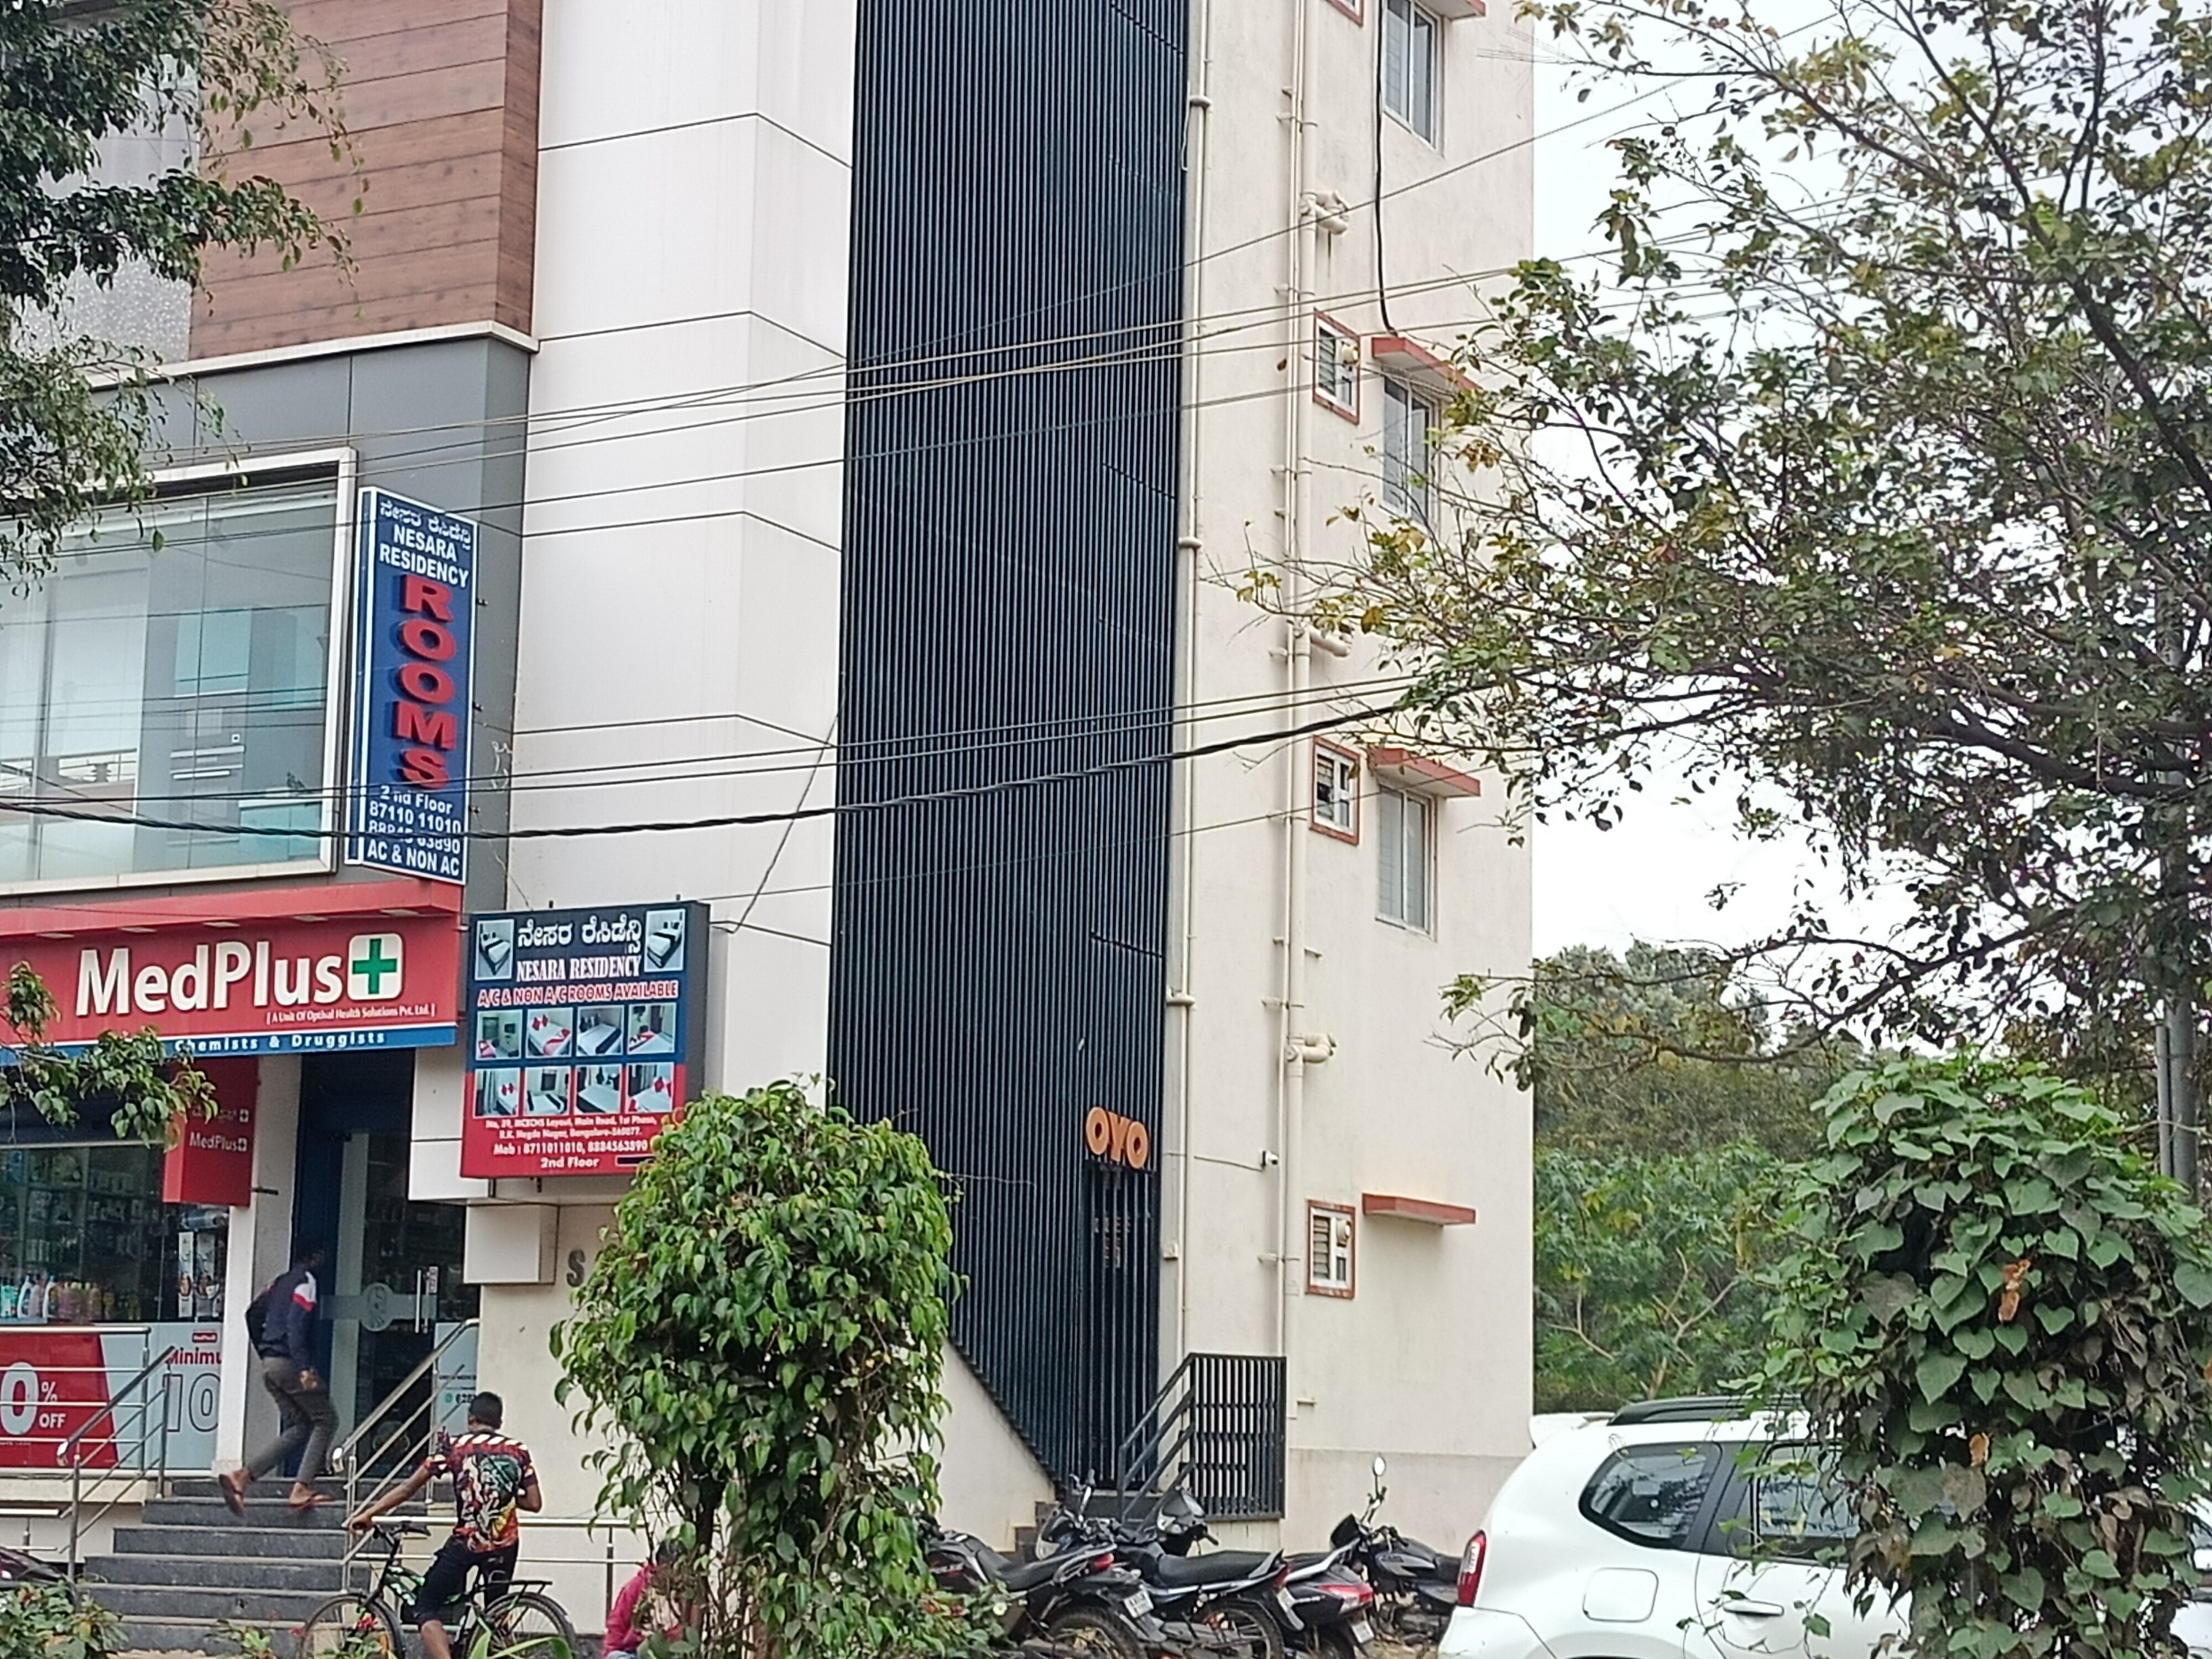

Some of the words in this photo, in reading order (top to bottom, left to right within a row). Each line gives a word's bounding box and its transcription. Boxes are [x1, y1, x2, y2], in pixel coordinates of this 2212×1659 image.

[393, 524, 457, 562] NESARA
[379, 543, 469, 588] RESIDENCY
[394, 573, 457, 789] ROOMS
[369, 801, 414, 825] 87110
[419, 812, 462, 834] 11010
[415, 794, 453, 815] Floor
[367, 839, 388, 860] AC
[392, 844, 402, 864] &
[406, 847, 437, 872] NON
[441, 855, 460, 876] AC
[518, 919, 573, 947] ನೇಸರ
[582, 914, 641, 953] ರೆಸಿಡೆನ್ಸಿ
[75, 940, 344, 1016] MedPlus
[516, 958, 566, 982] NESARA
[570, 955, 642, 979] RESIDENCY
[502, 988, 512, 1005] &
[514, 986, 544, 1005] NON
[568, 983, 612, 1003] ROOMS
[613, 980, 679, 1001] AVAILABLE
[279, 1011, 295, 1022] Unit
[296, 1010, 305, 1021] Of
[336, 1007, 361, 1019] Health
[362, 1006, 398, 1019] Solutions
[269, 1035, 280, 1048] &
[291, 1032, 384, 1048] Druggists
[189, 1131, 237, 1151] MedPlus
[493, 1142, 515, 1155] Mob
[1086, 1106, 1148, 1169] OYO
[540, 1155, 565, 1168] 2nd
[567, 1155, 599, 1168] Floor
[39, 1413, 66, 1428] OFF
